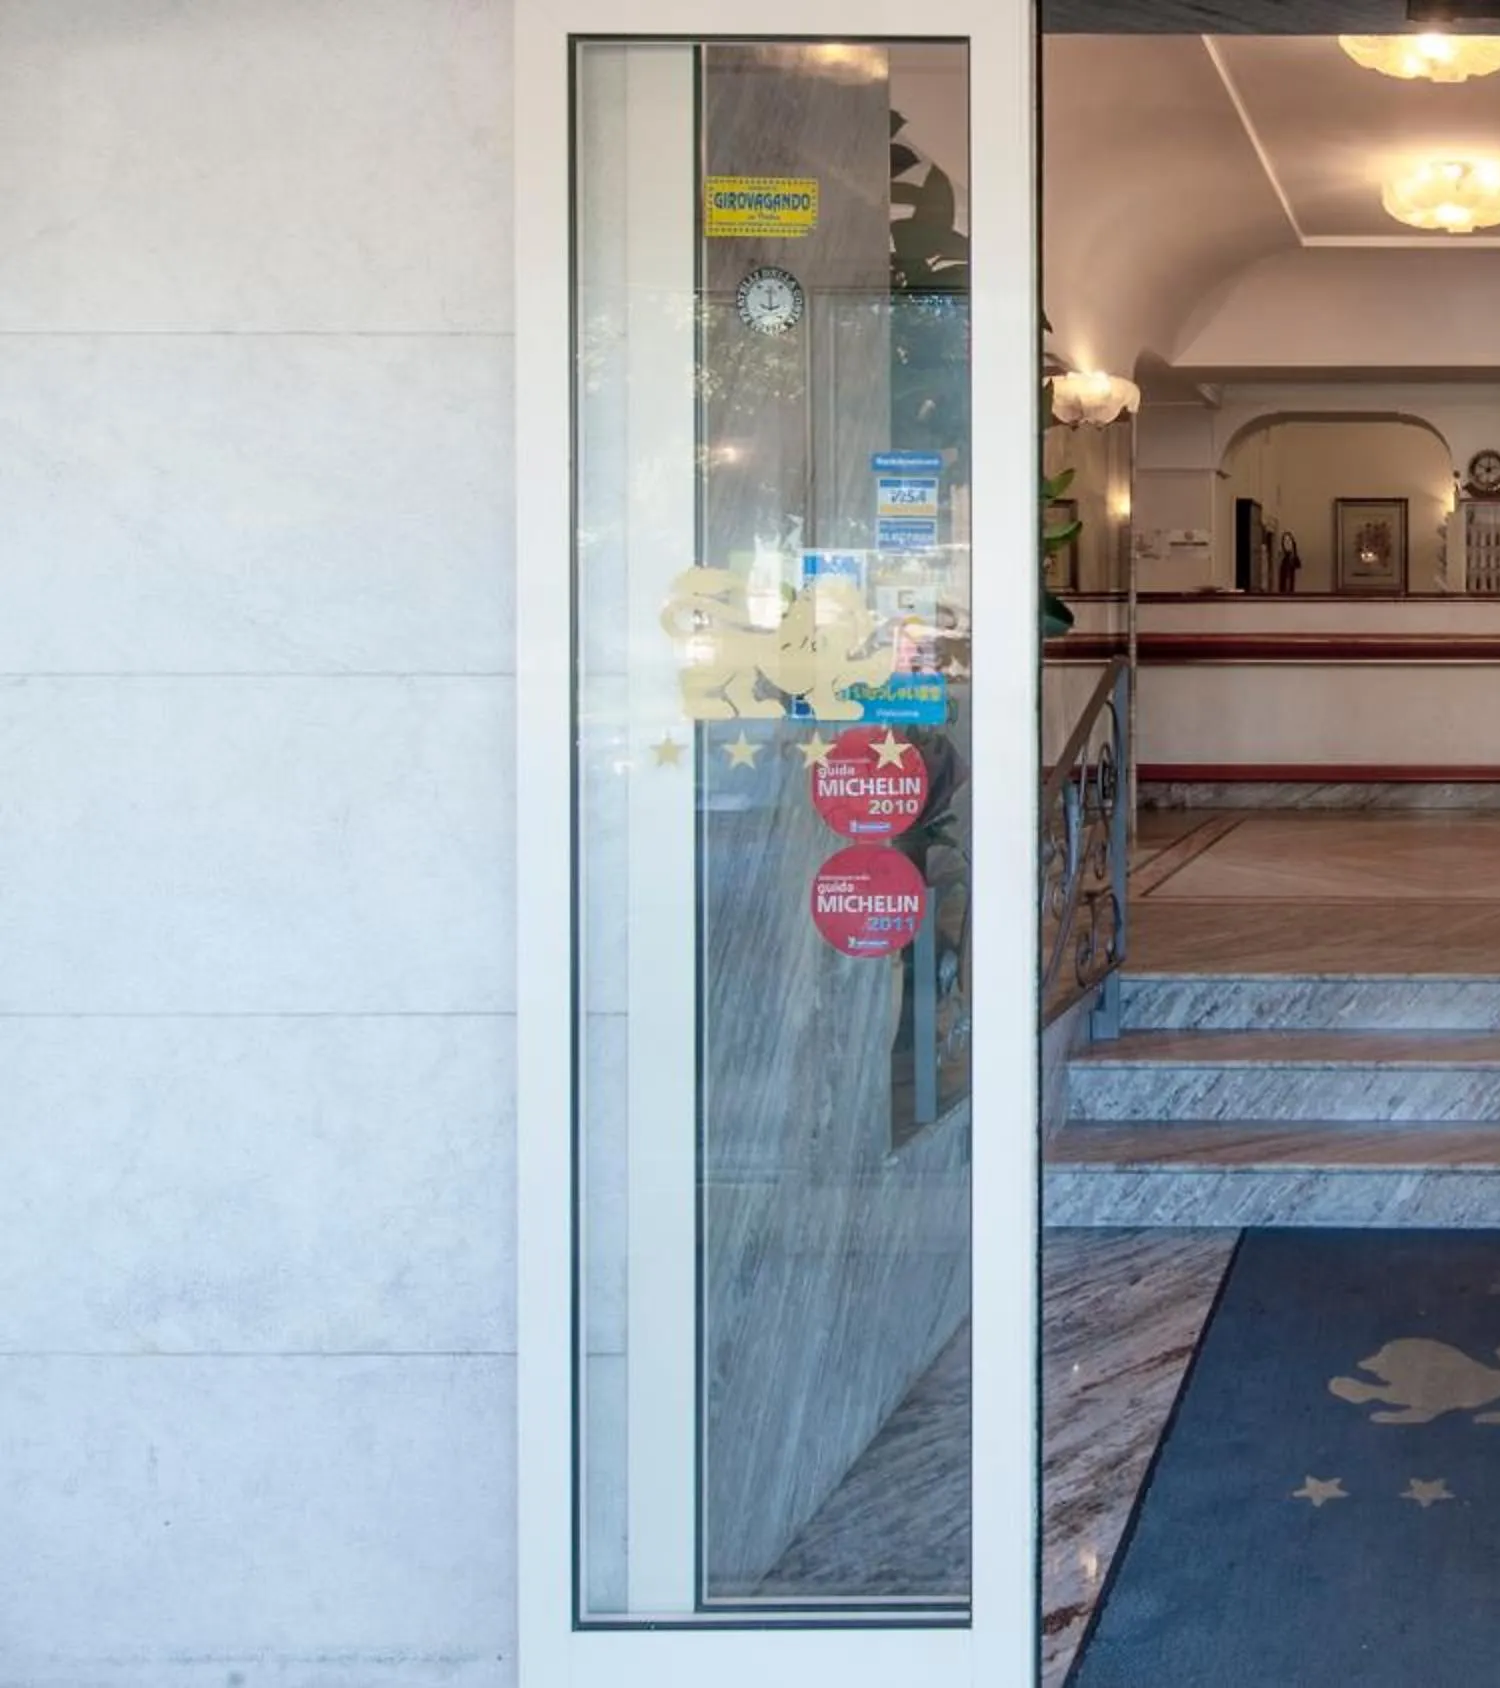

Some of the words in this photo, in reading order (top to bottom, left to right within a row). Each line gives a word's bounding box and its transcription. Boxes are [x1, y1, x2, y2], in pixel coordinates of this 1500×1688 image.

[713, 191, 811, 211] GIROVAGANDO
[889, 489, 927, 504] VISA
[817, 764, 856, 778] guida
[818, 777, 921, 797] MICHELIN
[868, 800, 919, 816] 2010
[817, 881, 855, 894] guida
[817, 895, 919, 913] MICHELIN
[867, 916, 916, 932] 2011
